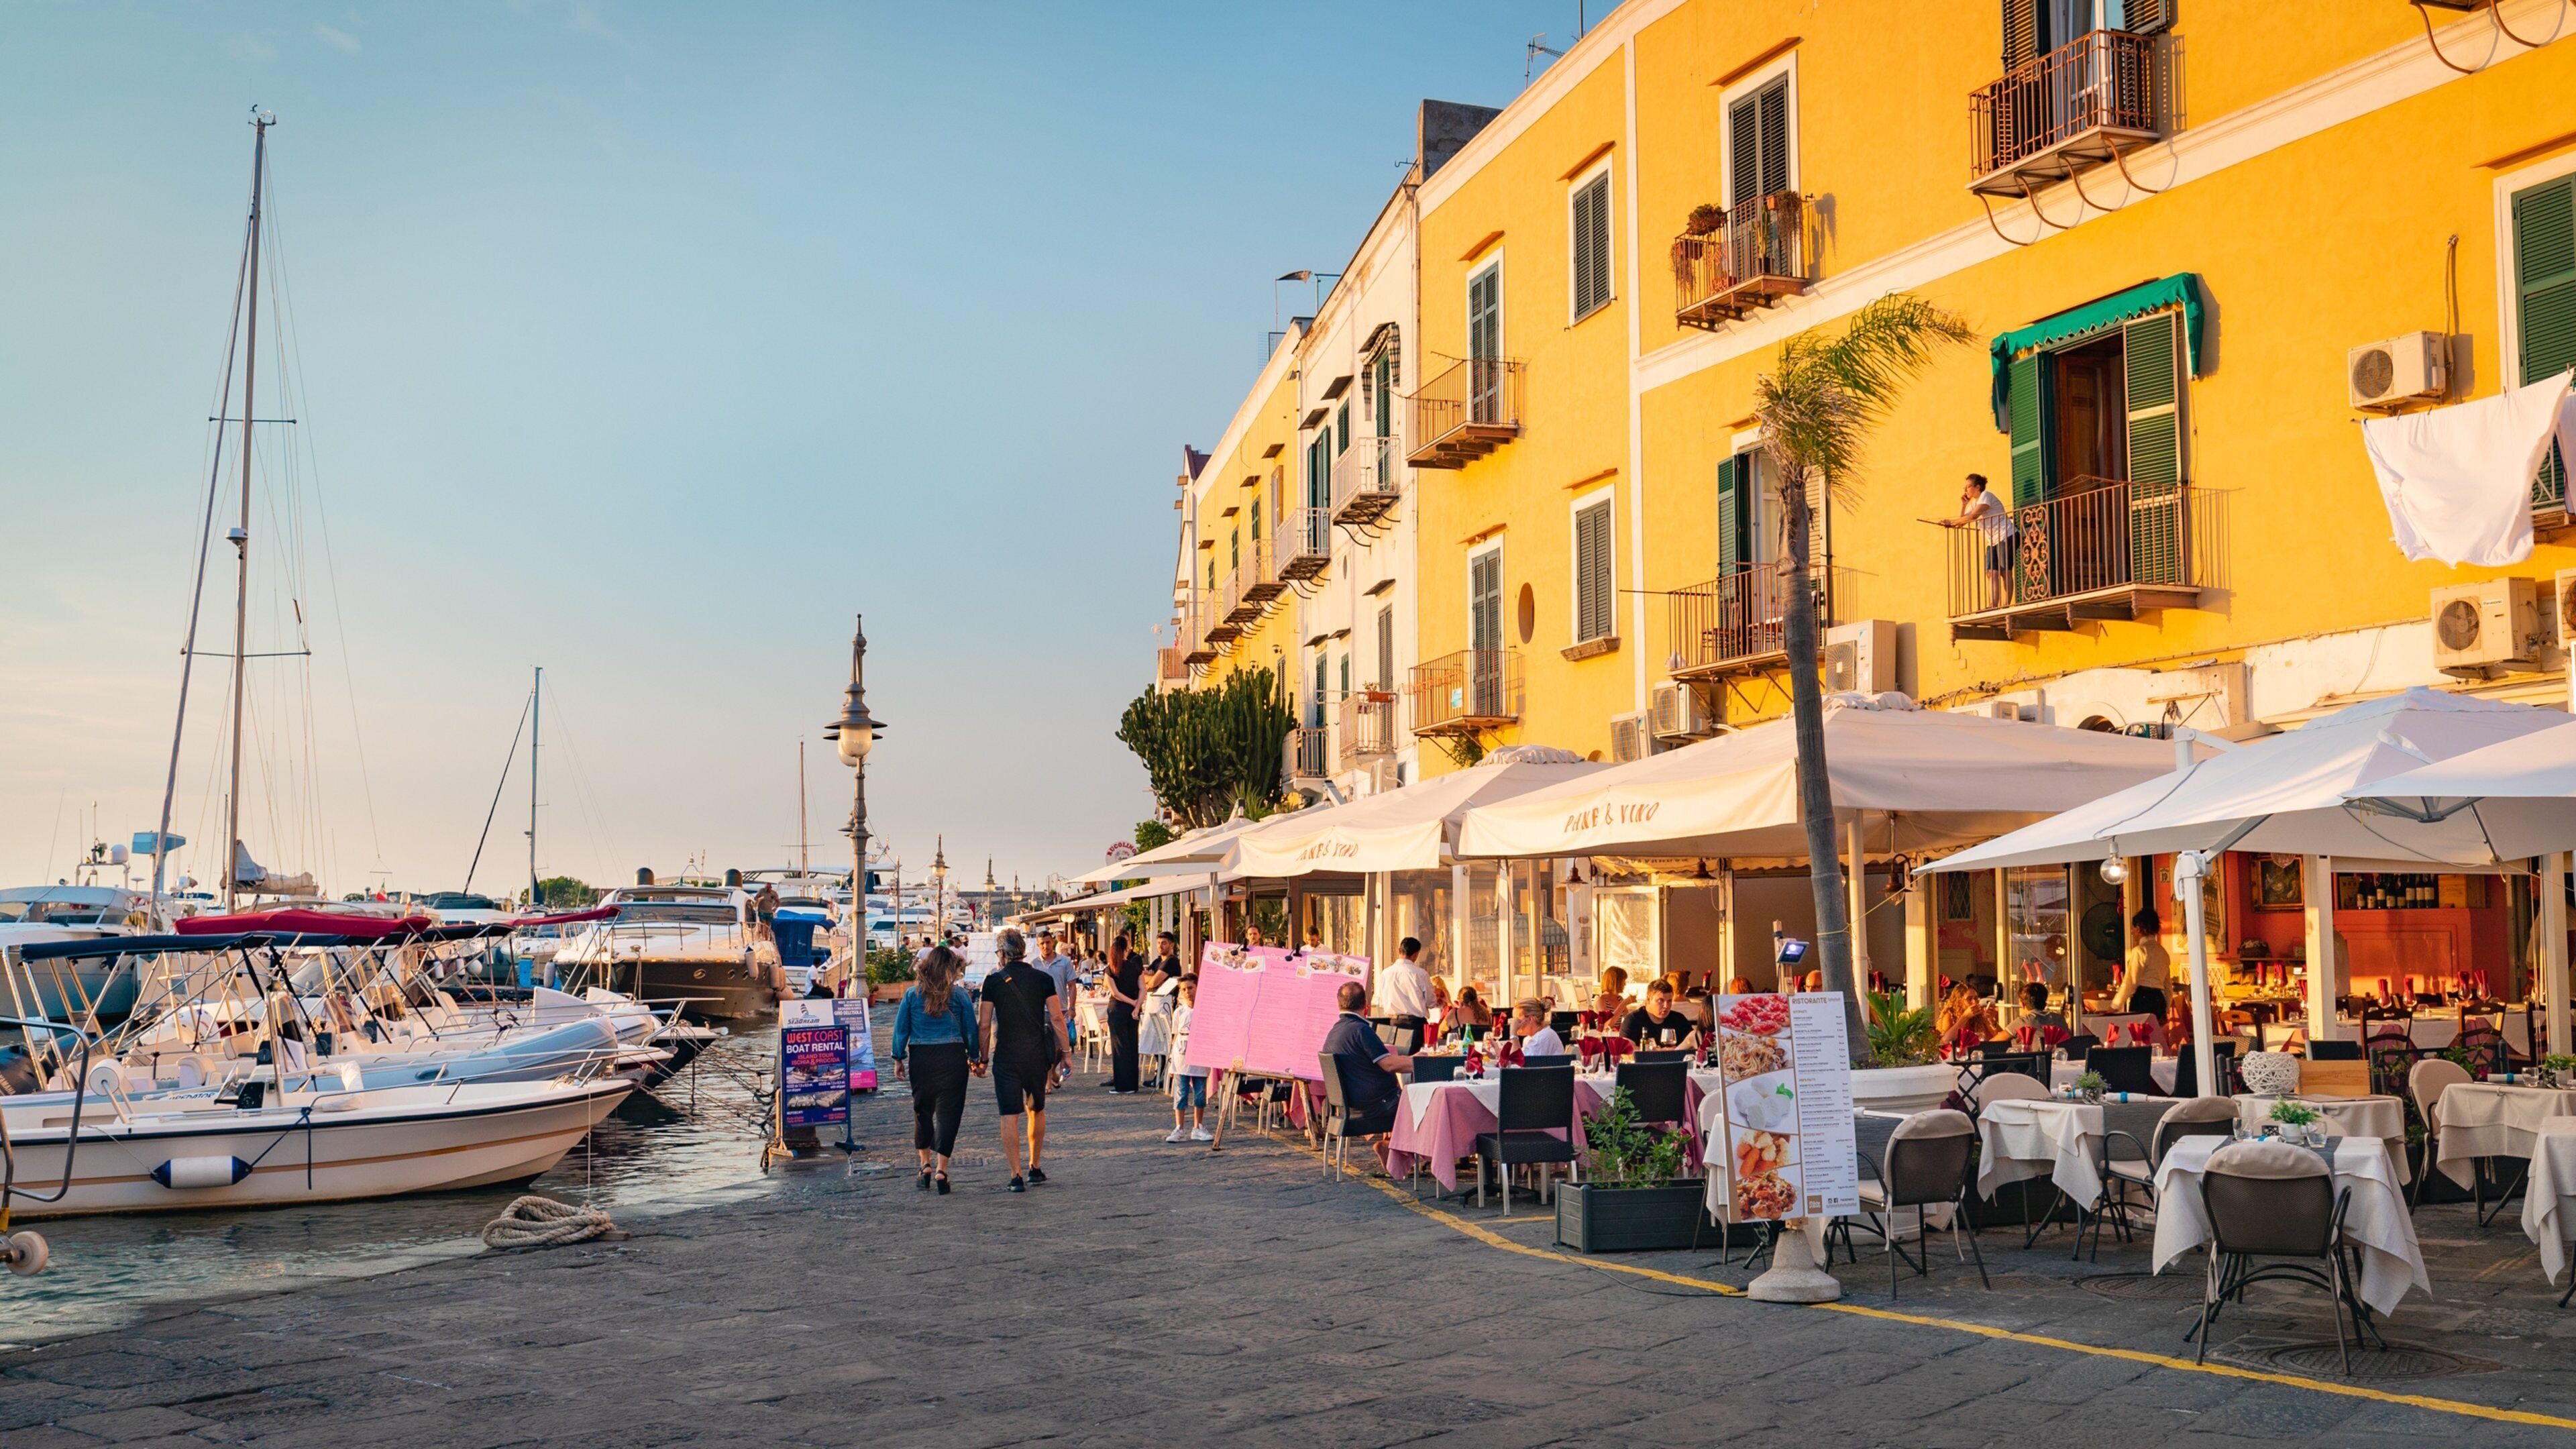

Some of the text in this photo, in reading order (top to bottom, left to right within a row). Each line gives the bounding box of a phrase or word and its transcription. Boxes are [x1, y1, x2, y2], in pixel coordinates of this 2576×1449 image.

[1564, 802, 1660, 833] PANE & VINO
[1107, 842, 1137, 857] RUCOLINO
[787, 1030, 843, 1044] WEST COAST
[786, 1042, 845, 1054] BOAT RENTAL
[169, 1092, 215, 1100] REDATOR
